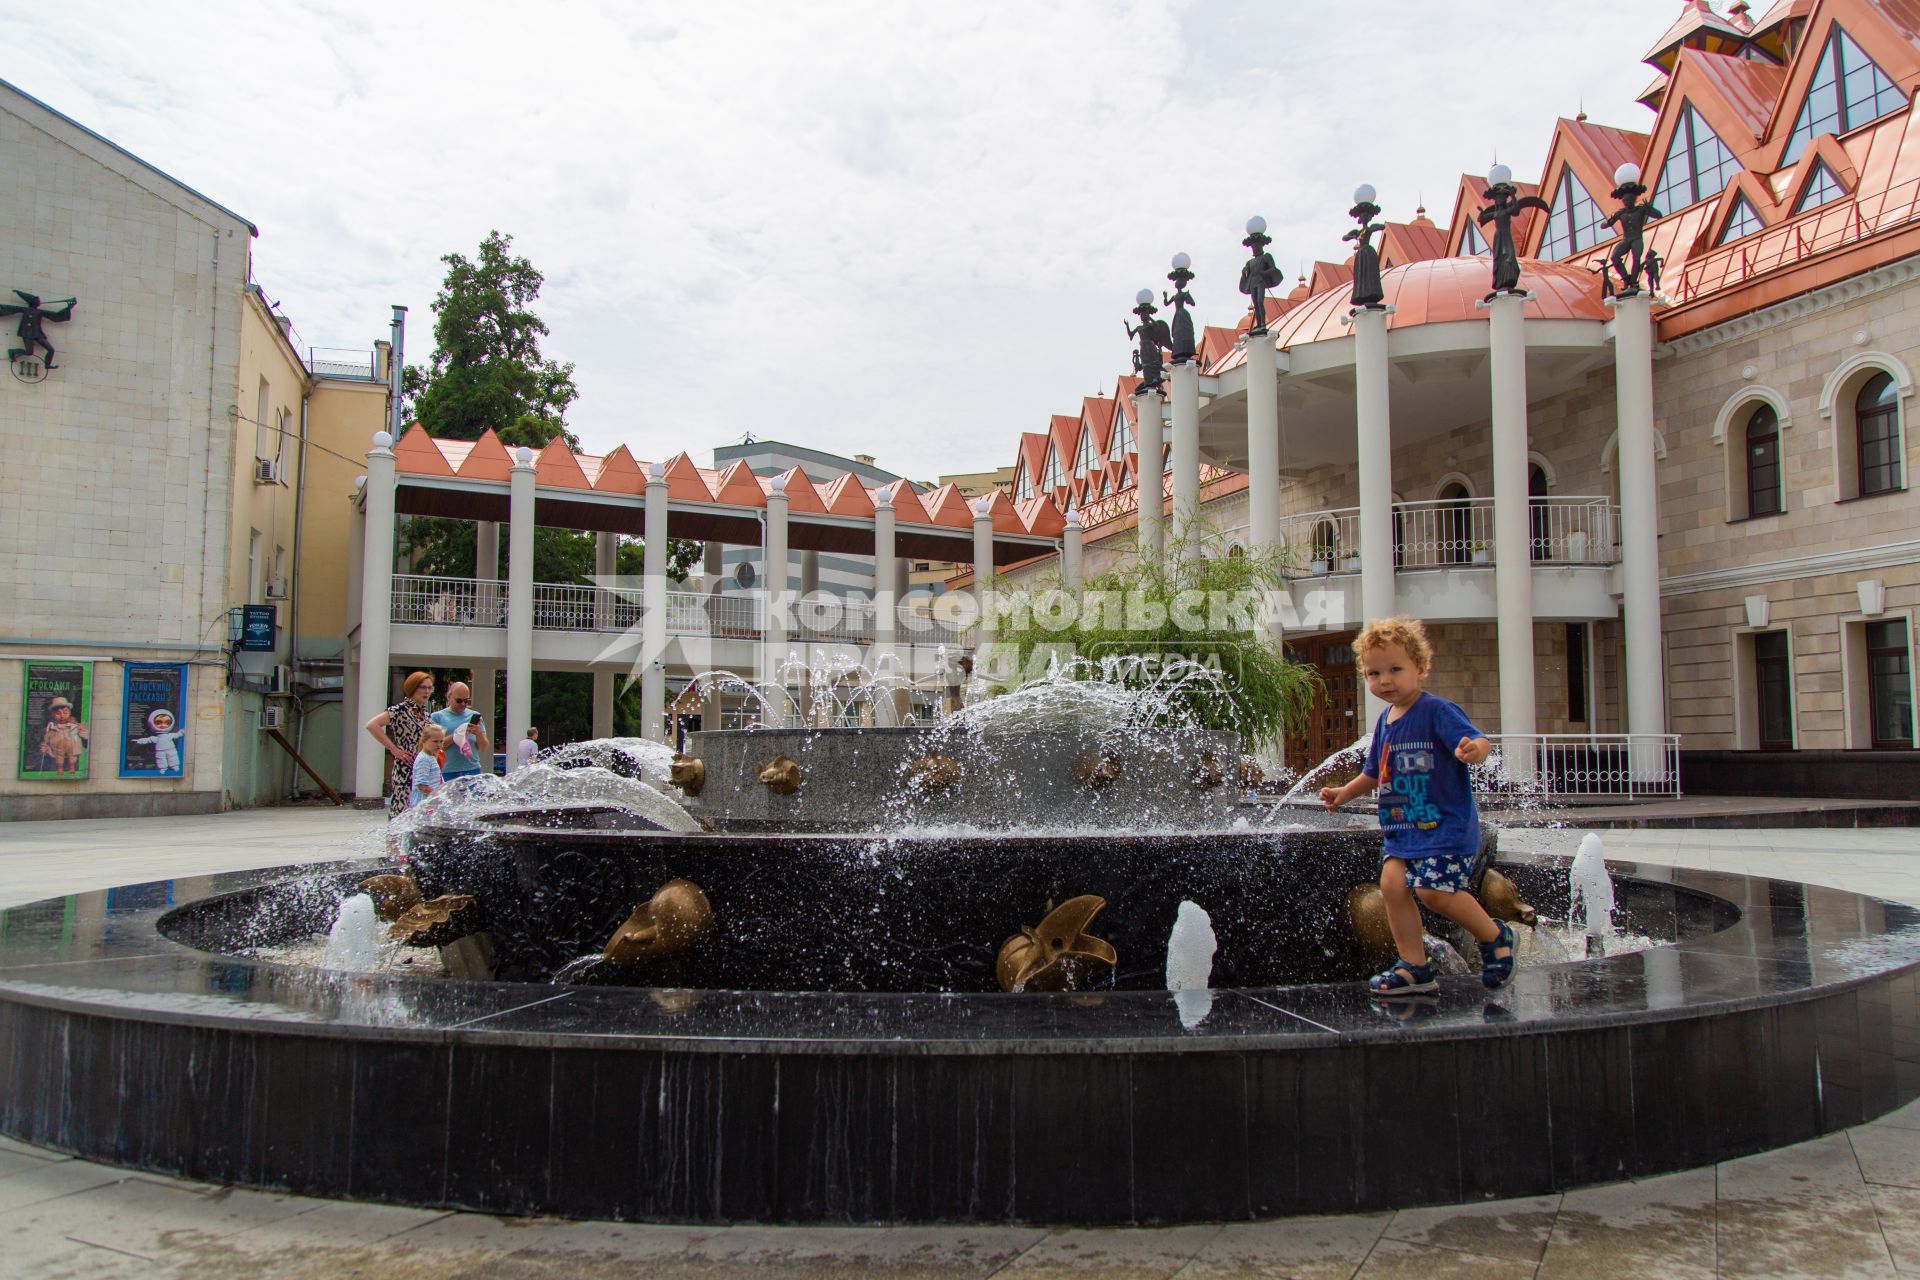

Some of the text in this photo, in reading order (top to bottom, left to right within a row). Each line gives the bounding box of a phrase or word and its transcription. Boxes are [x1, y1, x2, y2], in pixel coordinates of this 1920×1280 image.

[29, 680, 70, 690] КРОКОДИЛ
[1393, 774, 1430, 794] OUT
[1410, 793, 1428, 806] OF
